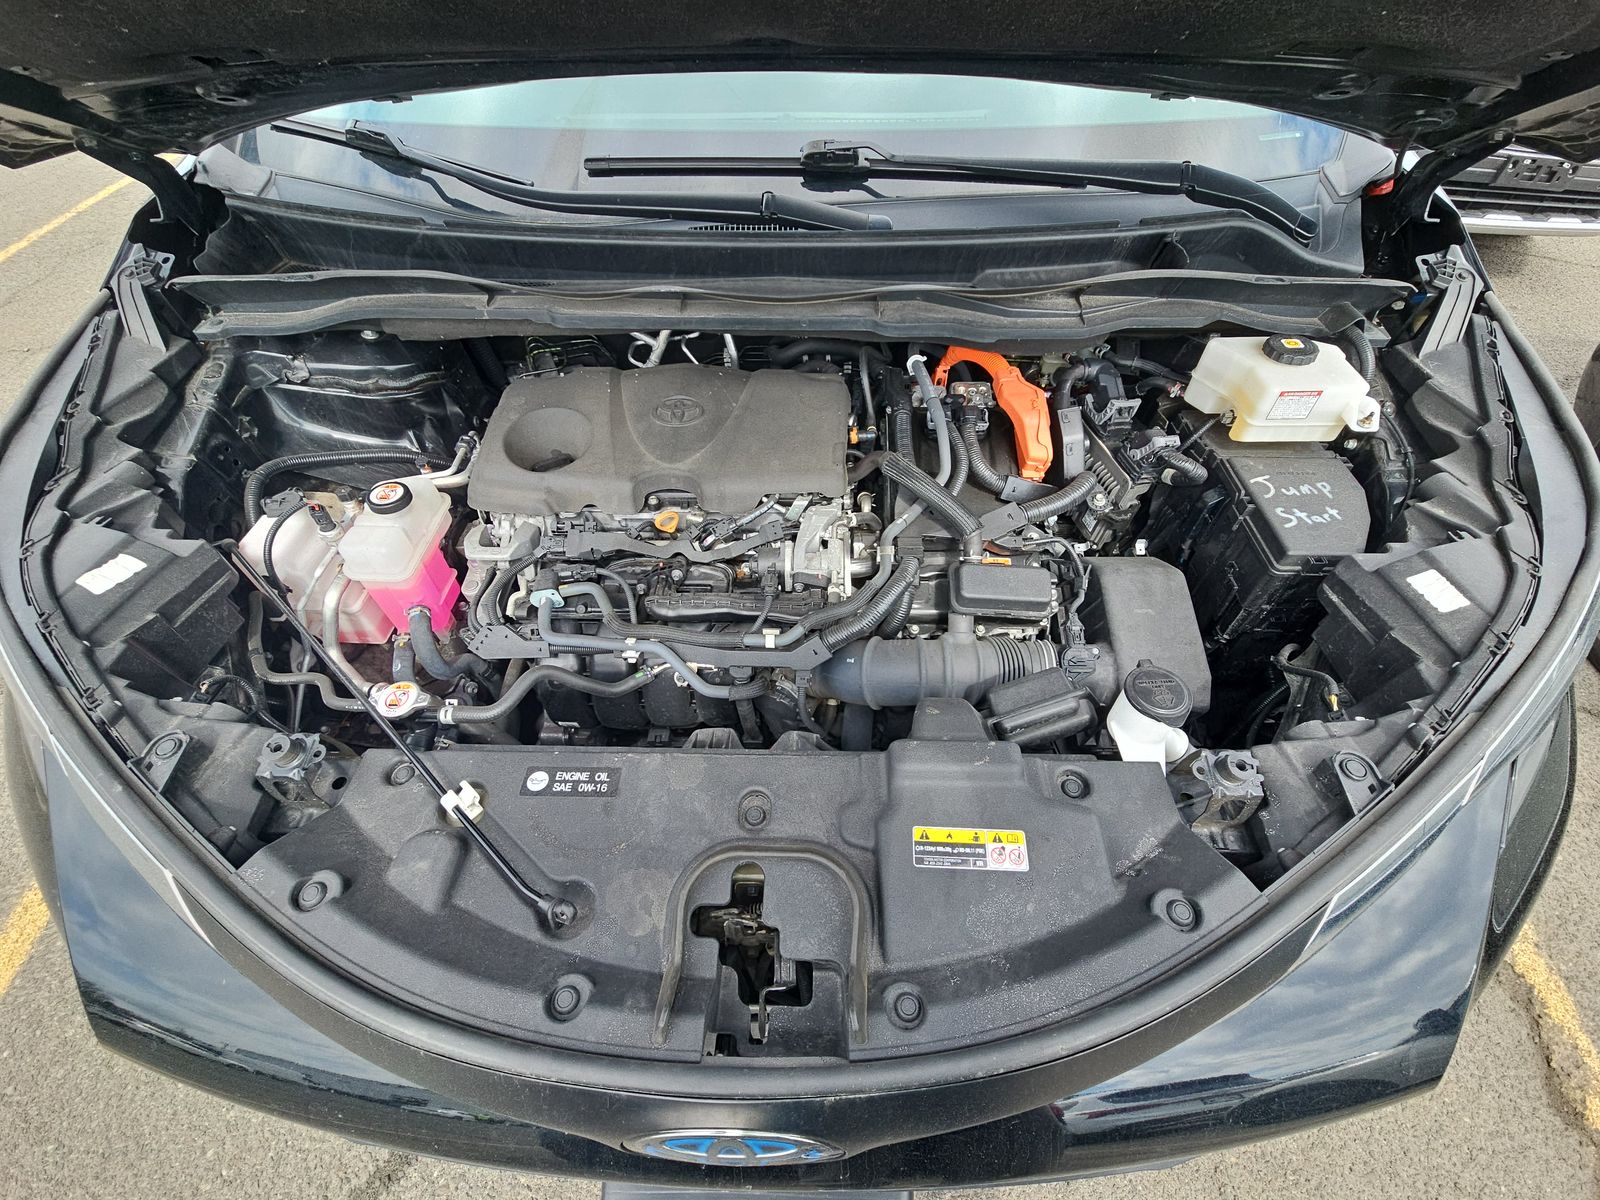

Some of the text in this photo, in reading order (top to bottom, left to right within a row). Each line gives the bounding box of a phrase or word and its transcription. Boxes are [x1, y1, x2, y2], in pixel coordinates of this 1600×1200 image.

[1249, 475, 1333, 499] Jump
[1275, 506, 1342, 528] Start
[555, 772, 610, 781] ENGINE OIL
[552, 783, 608, 792] SAE 0W-16
